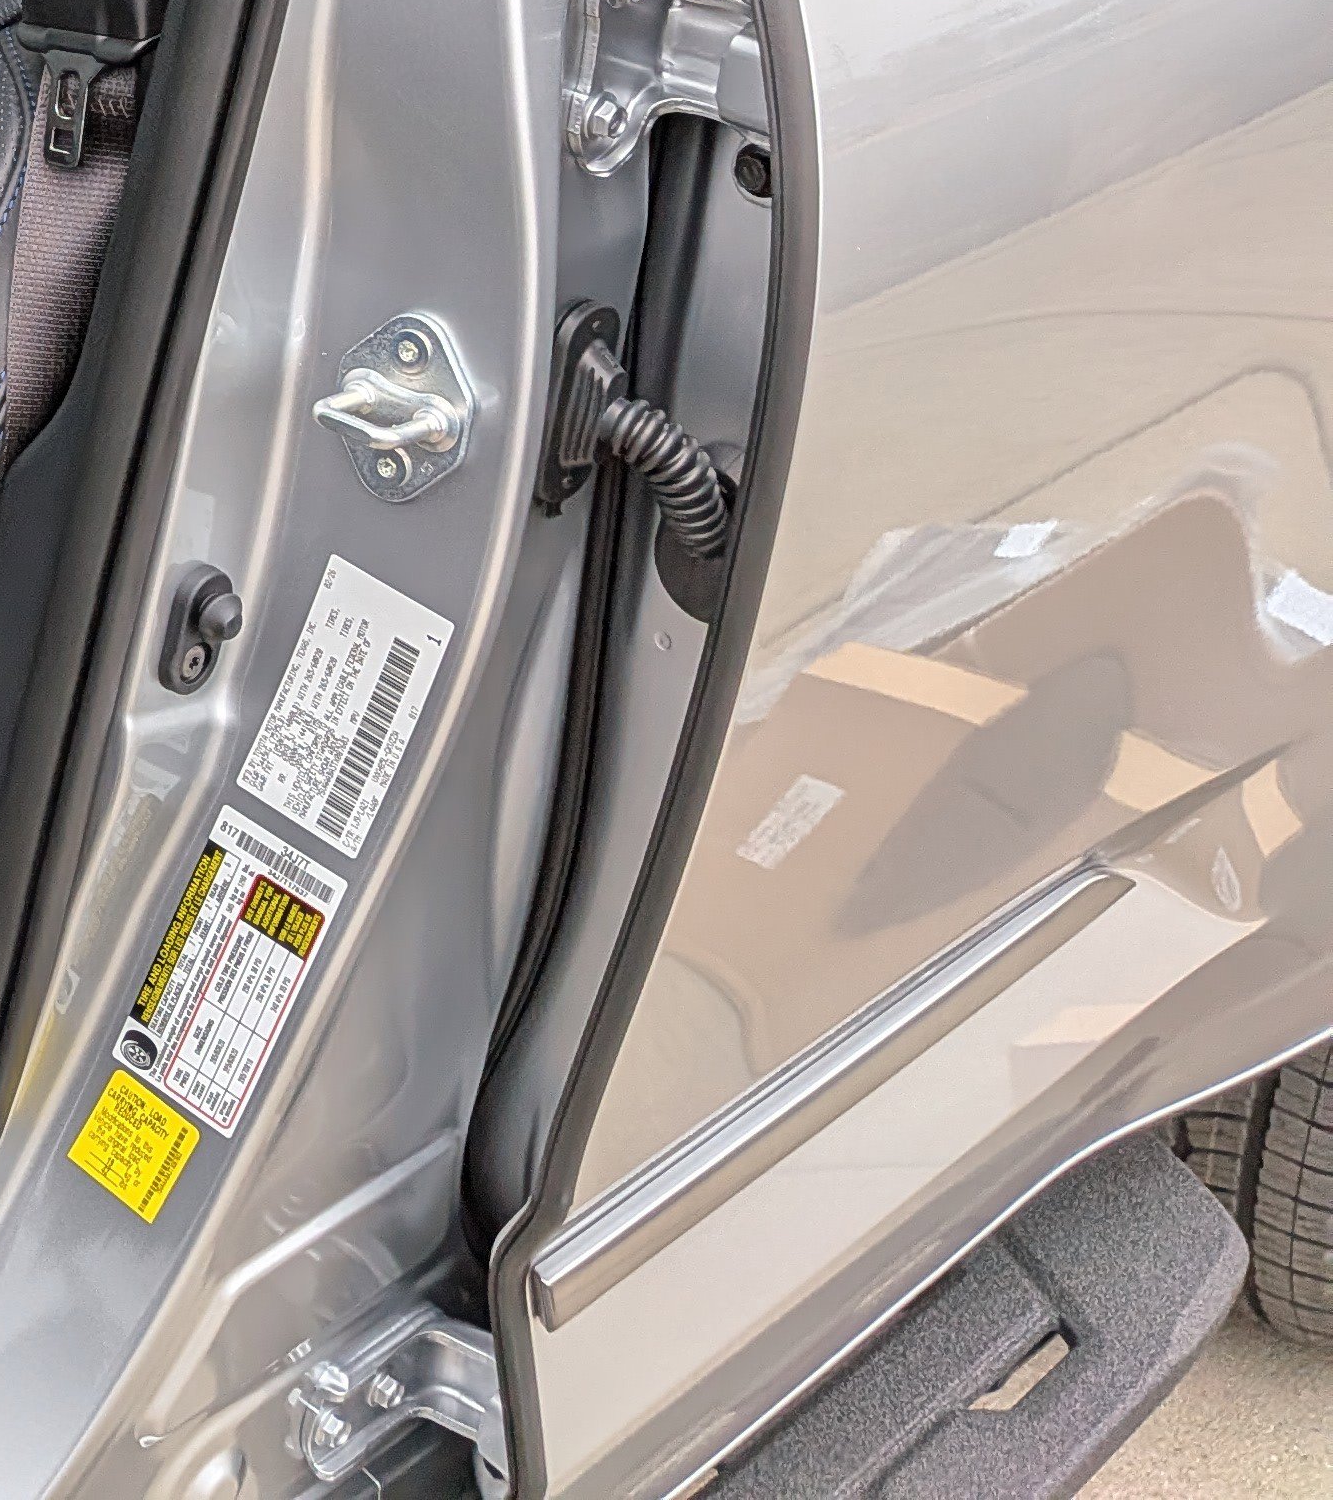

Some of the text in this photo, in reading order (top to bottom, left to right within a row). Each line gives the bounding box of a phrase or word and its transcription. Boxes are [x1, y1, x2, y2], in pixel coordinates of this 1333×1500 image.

[425, 632, 442, 646] 1
[322, 707, 334, 721] ALL
[355, 617, 370, 640] MOTOR
[349, 665, 361, 679] THE
[252, 732, 268, 758] TOYOTA
[263, 711, 278, 734] MOTOR
[218, 819, 239, 840] 817
[243, 879, 267, 921] SEE OWNER'S
[251, 884, 275, 925] MANUAL FOR
[260, 891, 281, 929] ADDITIONAL
[266, 893, 291, 937] INFORMATION
[136, 853, 211, 1008] TIRE AND LOADING INFORMATION
[140, 848, 223, 1022] RENSEIGNEMENTS SUR LES PNEUS ET LE CHARGEMENT
[149, 882, 219, 1030] SEATING CAPACITY TOTAL FRONT REAR
[213, 933, 244, 993] COLD TIRE PRESSURE
[216, 978, 233, 1005] PRESSION
[192, 1024, 203, 1039] SIZE
[193, 1017, 214, 1055] DIMENSIONS
[172, 1067, 183, 1083] TIRE
[179, 1070, 190, 1088] PNEU
[105, 1086, 170, 1141] CARRYING CAPACITY
[112, 1103, 143, 1130] REDUCED
[148, 1107, 168, 1127] LOAD
